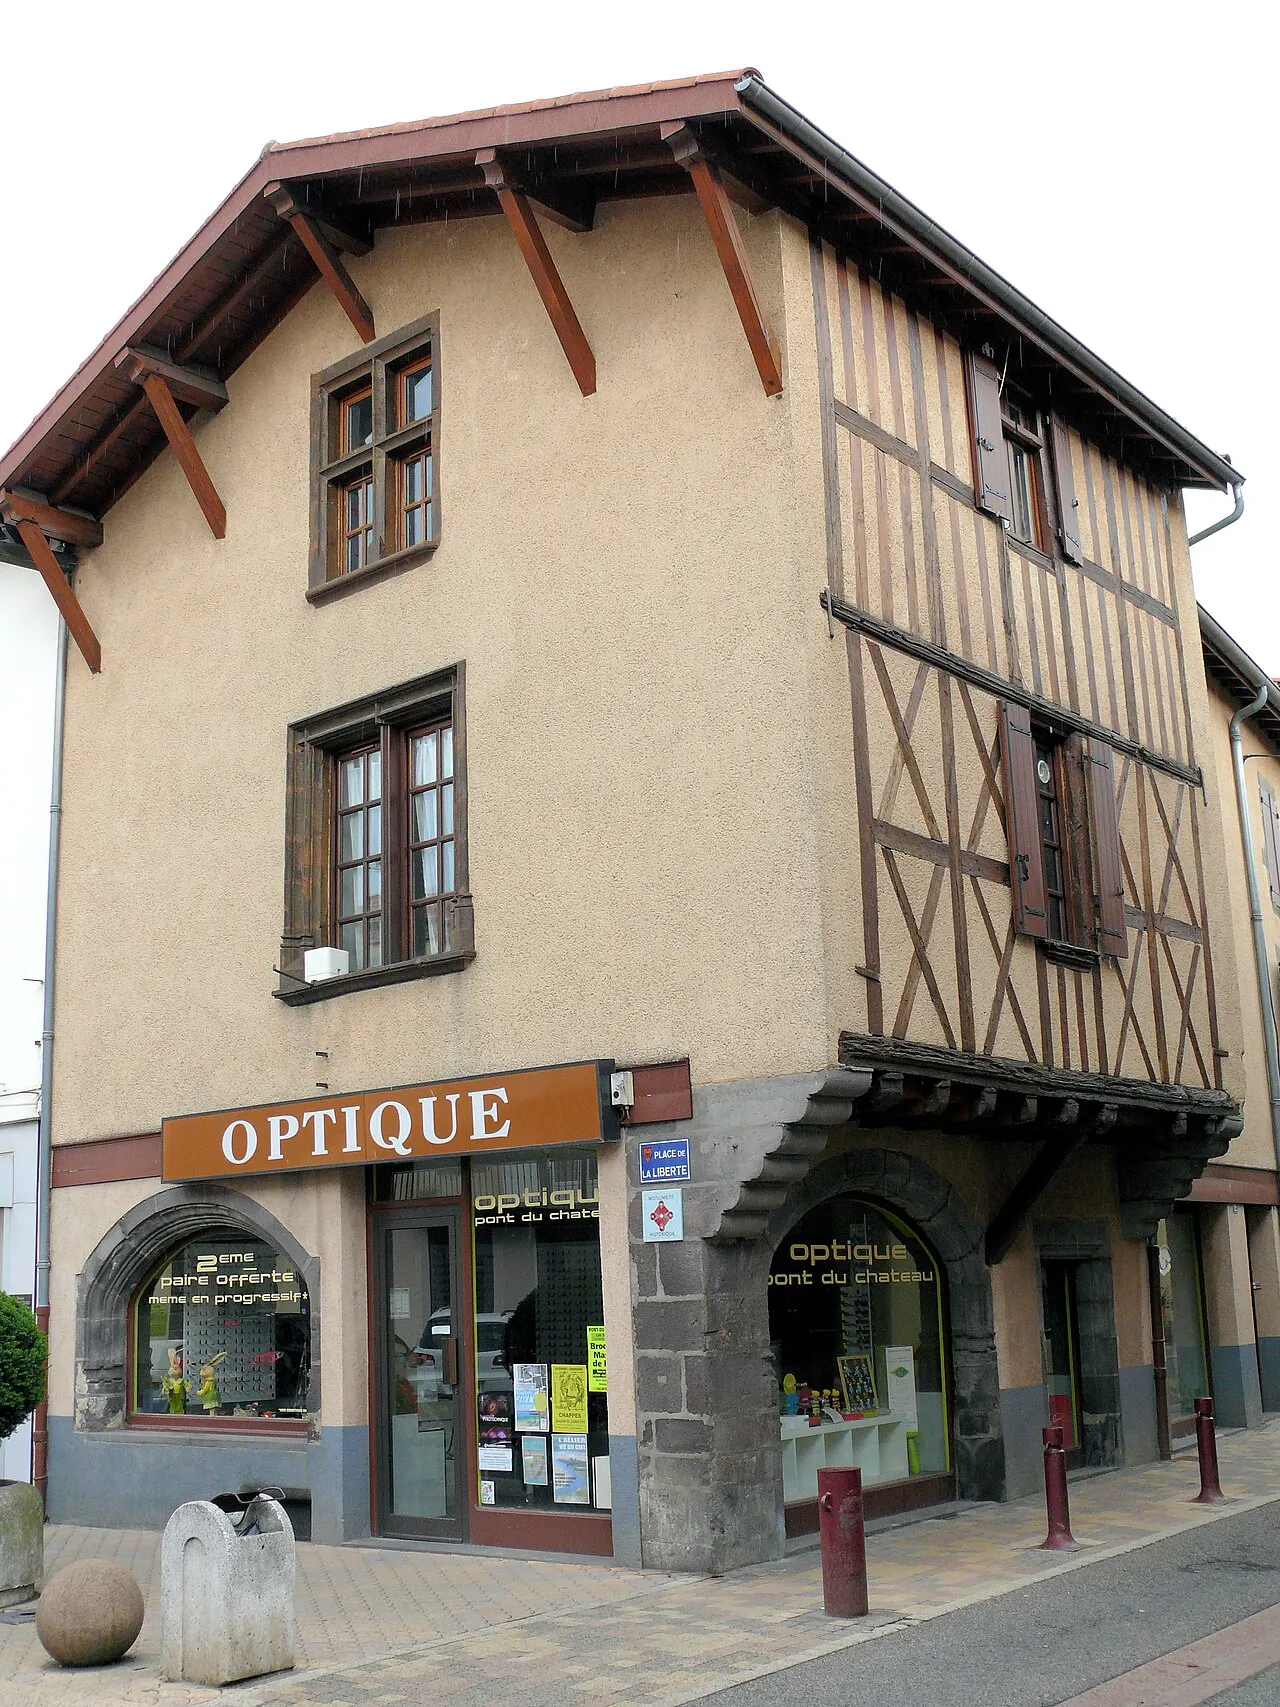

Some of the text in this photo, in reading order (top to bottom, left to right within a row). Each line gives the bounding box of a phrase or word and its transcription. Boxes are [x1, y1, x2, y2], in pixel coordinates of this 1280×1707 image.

[222, 1087, 511, 1165] OPTIQUE
[654, 1149, 686, 1159] PLACE DE
[642, 1165, 688, 1178] LA LIBERTE
[475, 1213, 515, 1227] pont
[521, 1212, 543, 1222] du
[789, 1239, 907, 1266] optique
[160, 1269, 294, 1290] paire offerte
[821, 1270, 847, 1285] du
[855, 1269, 933, 1284] chateau
[148, 1296, 187, 1304] meme
[191, 1295, 209, 1304] en
[593, 1351, 606, 1359] Ma
[592, 1359, 602, 1367] de
